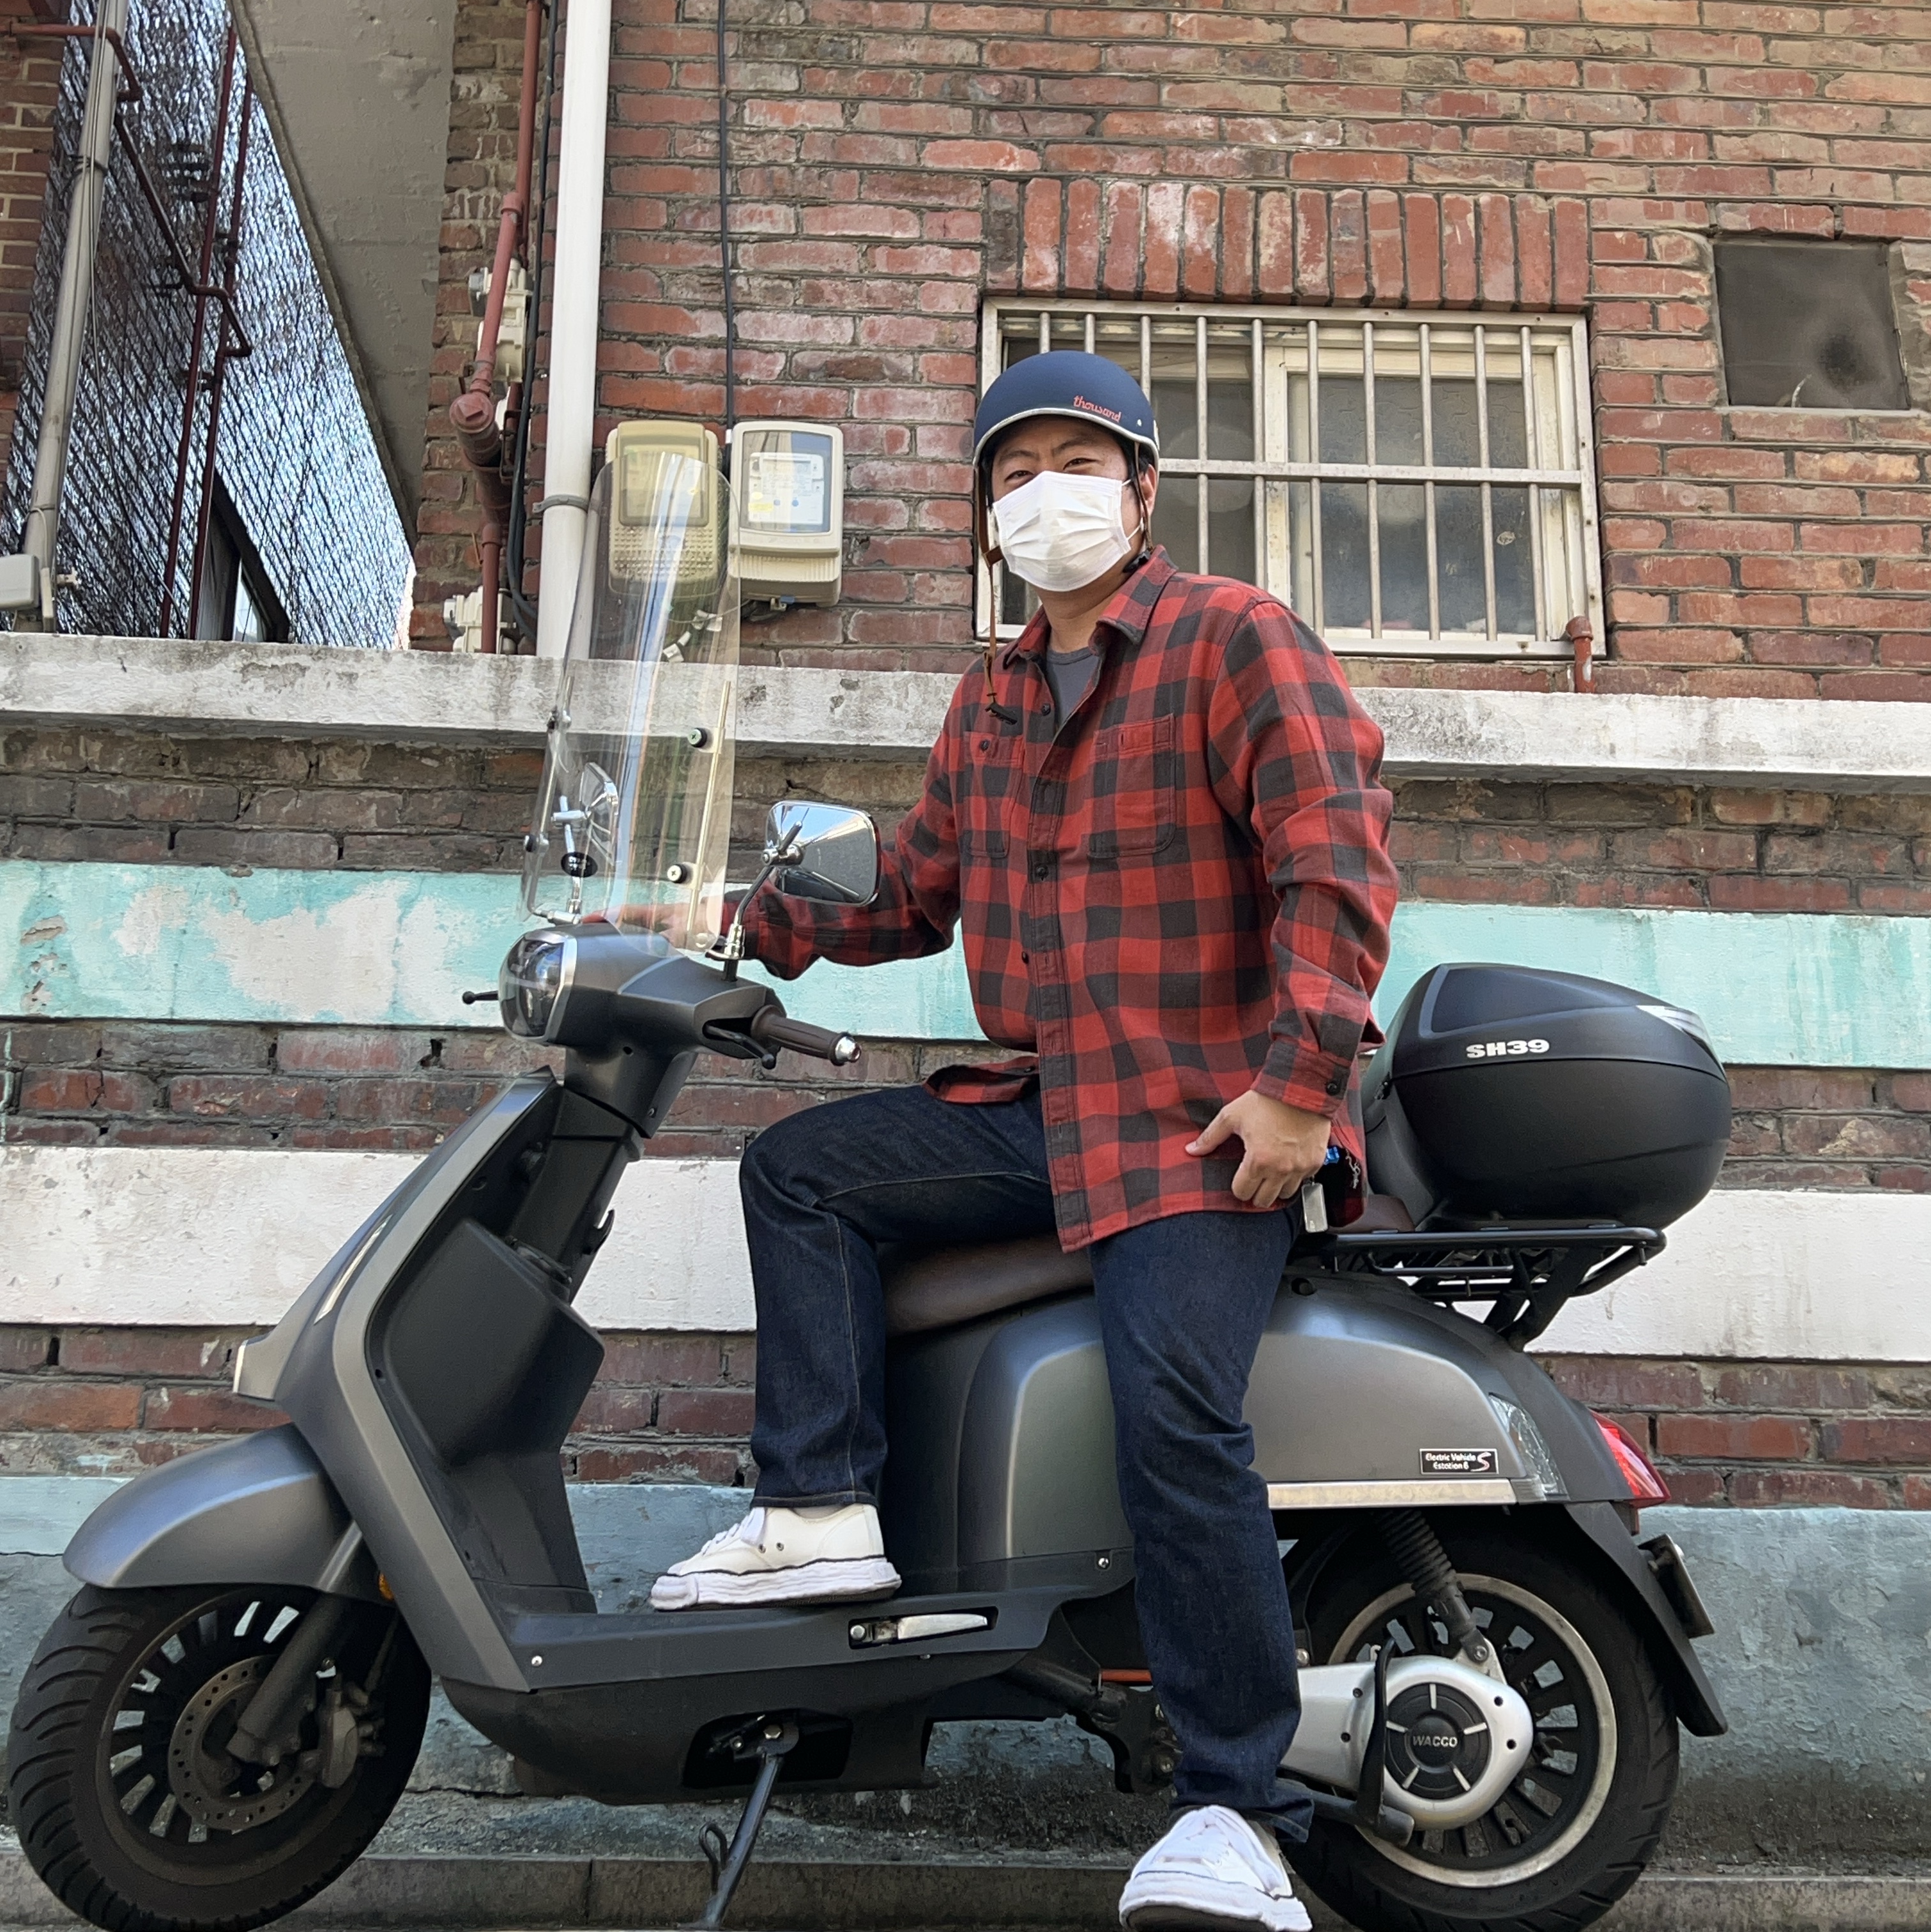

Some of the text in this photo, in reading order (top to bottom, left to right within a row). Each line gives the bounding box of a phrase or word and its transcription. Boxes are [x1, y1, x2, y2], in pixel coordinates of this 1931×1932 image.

[1074, 395, 1122, 422] thousand
[1466, 1038, 1550, 1058] SH39
[1425, 1452, 1476, 1461] Electric Vehicle
[1413, 1735, 1458, 1748] WACCO
